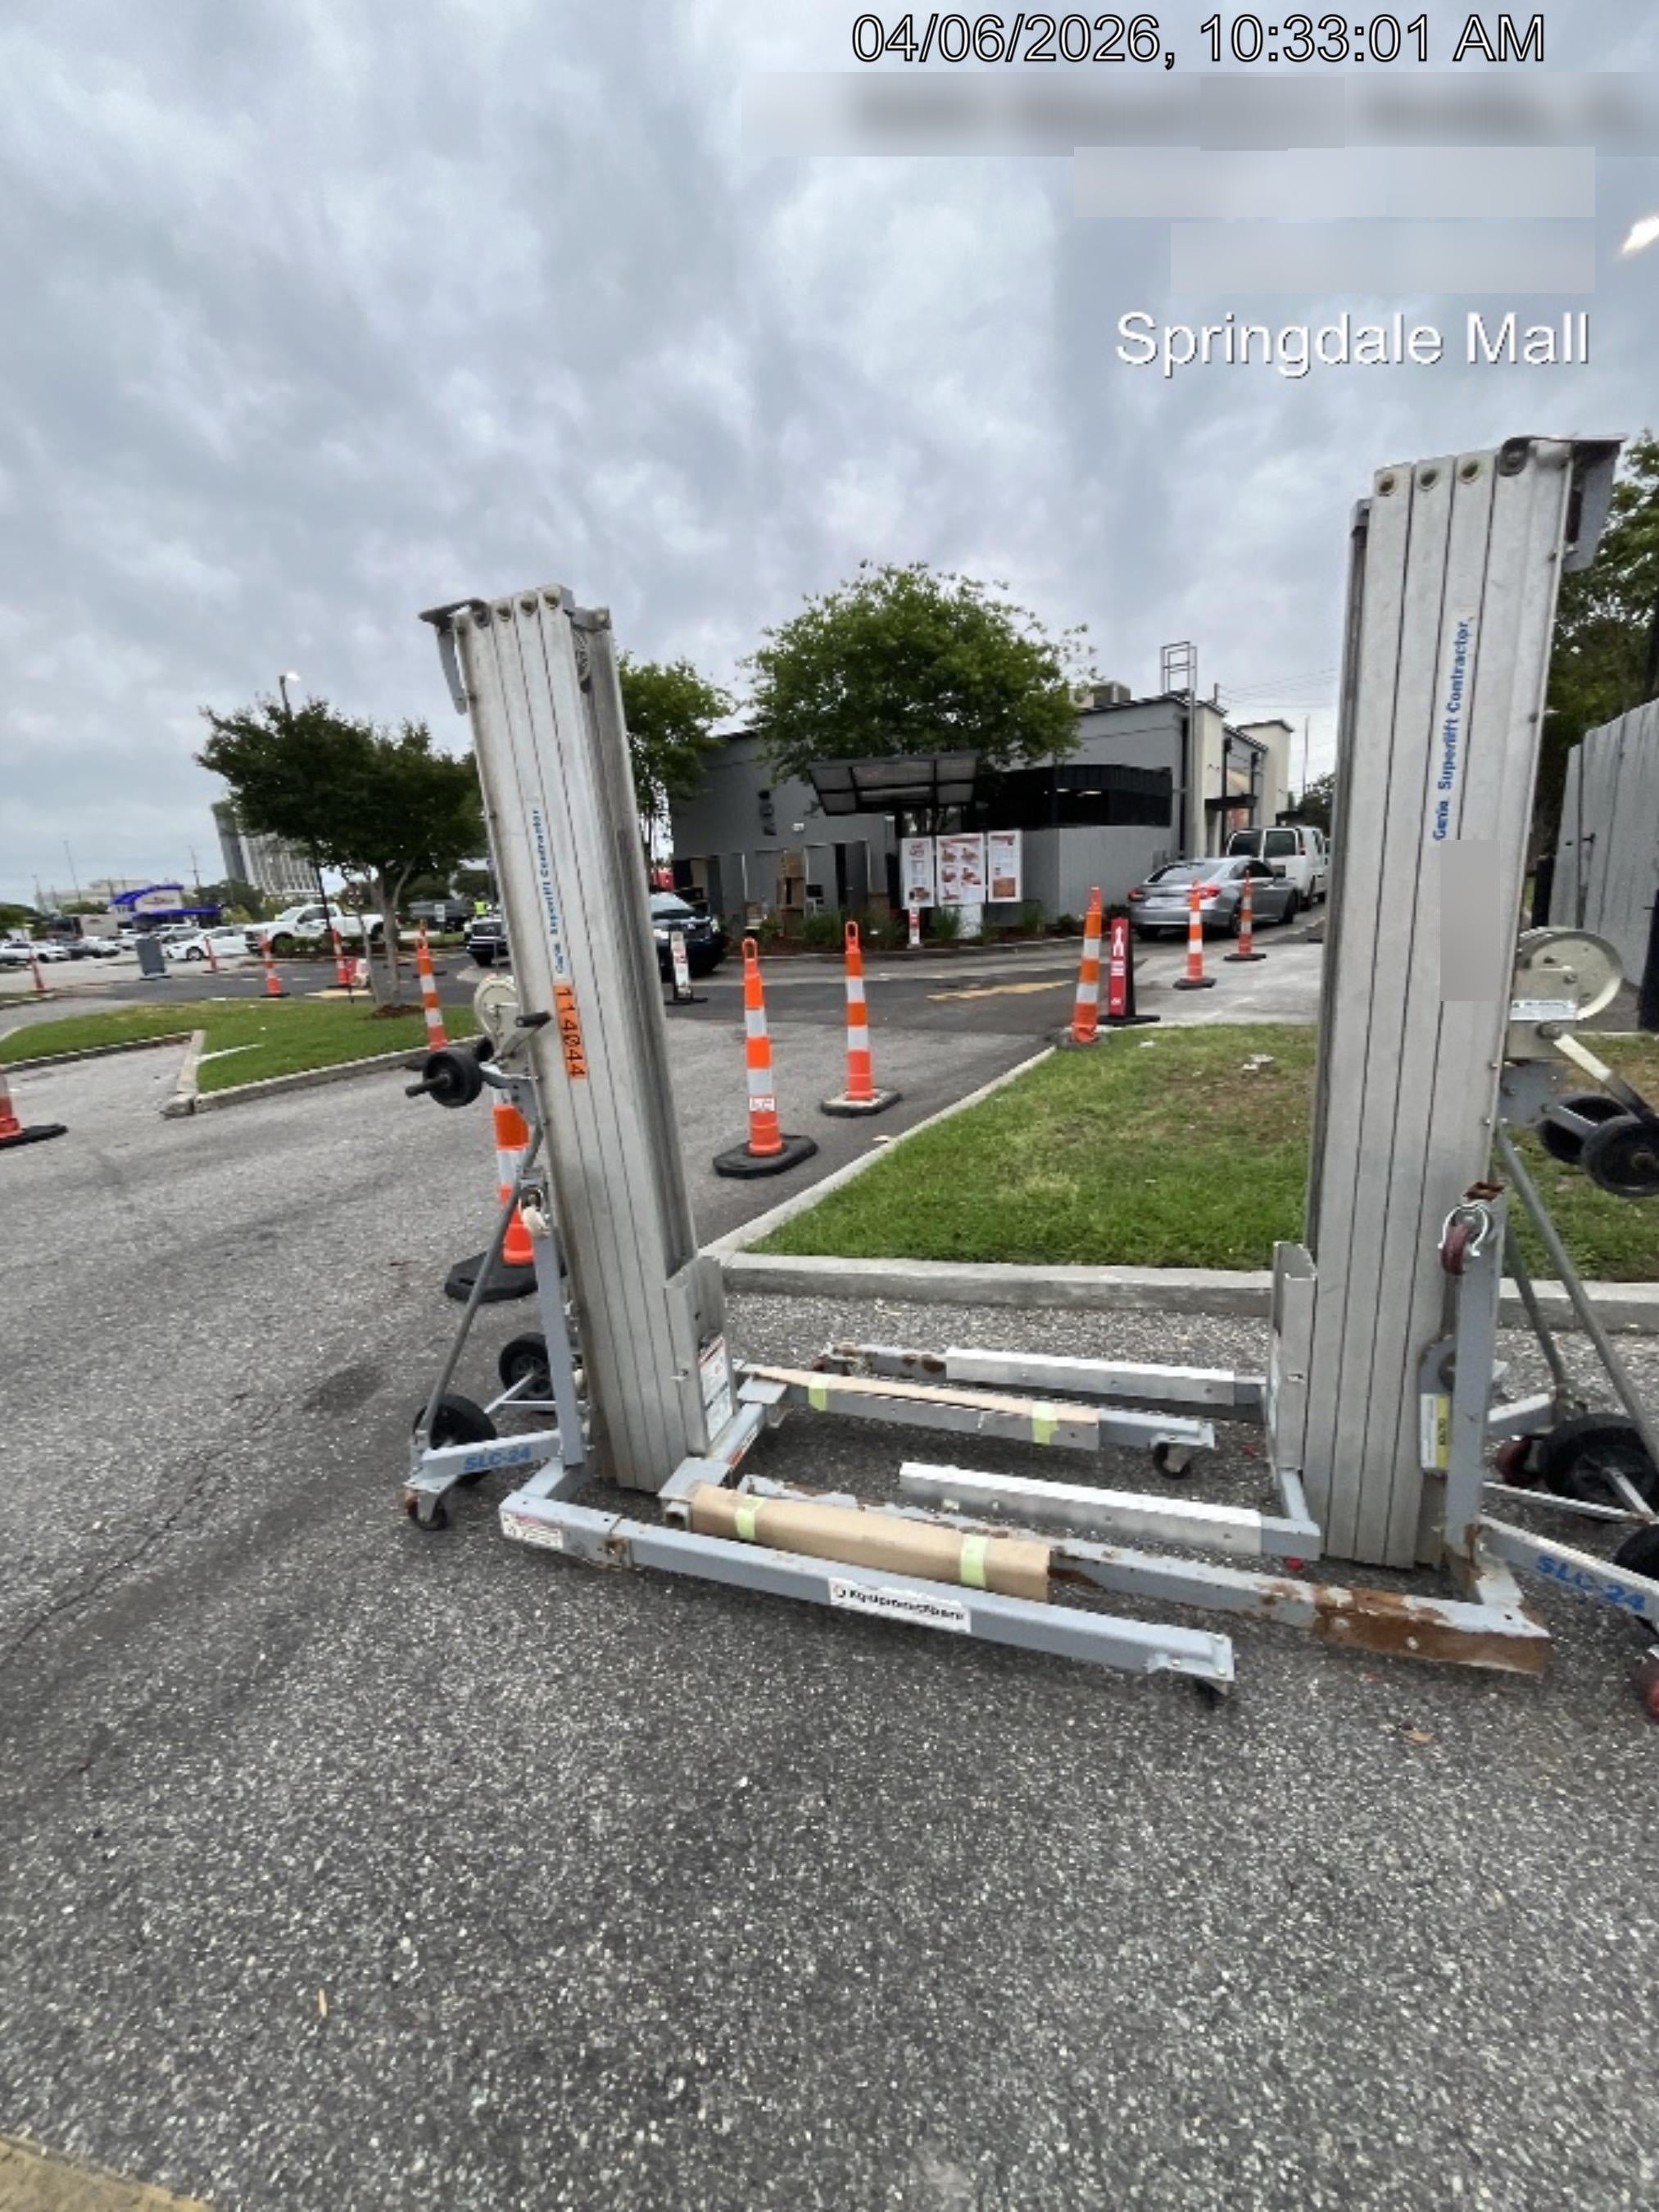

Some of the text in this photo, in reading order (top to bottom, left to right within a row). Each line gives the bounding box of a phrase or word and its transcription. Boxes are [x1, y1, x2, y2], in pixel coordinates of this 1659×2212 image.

[1445, 622, 1470, 713] Contractor
[1438, 718, 1460, 790] Superlift
[1537, 1555, 1646, 1611] SLC-24
